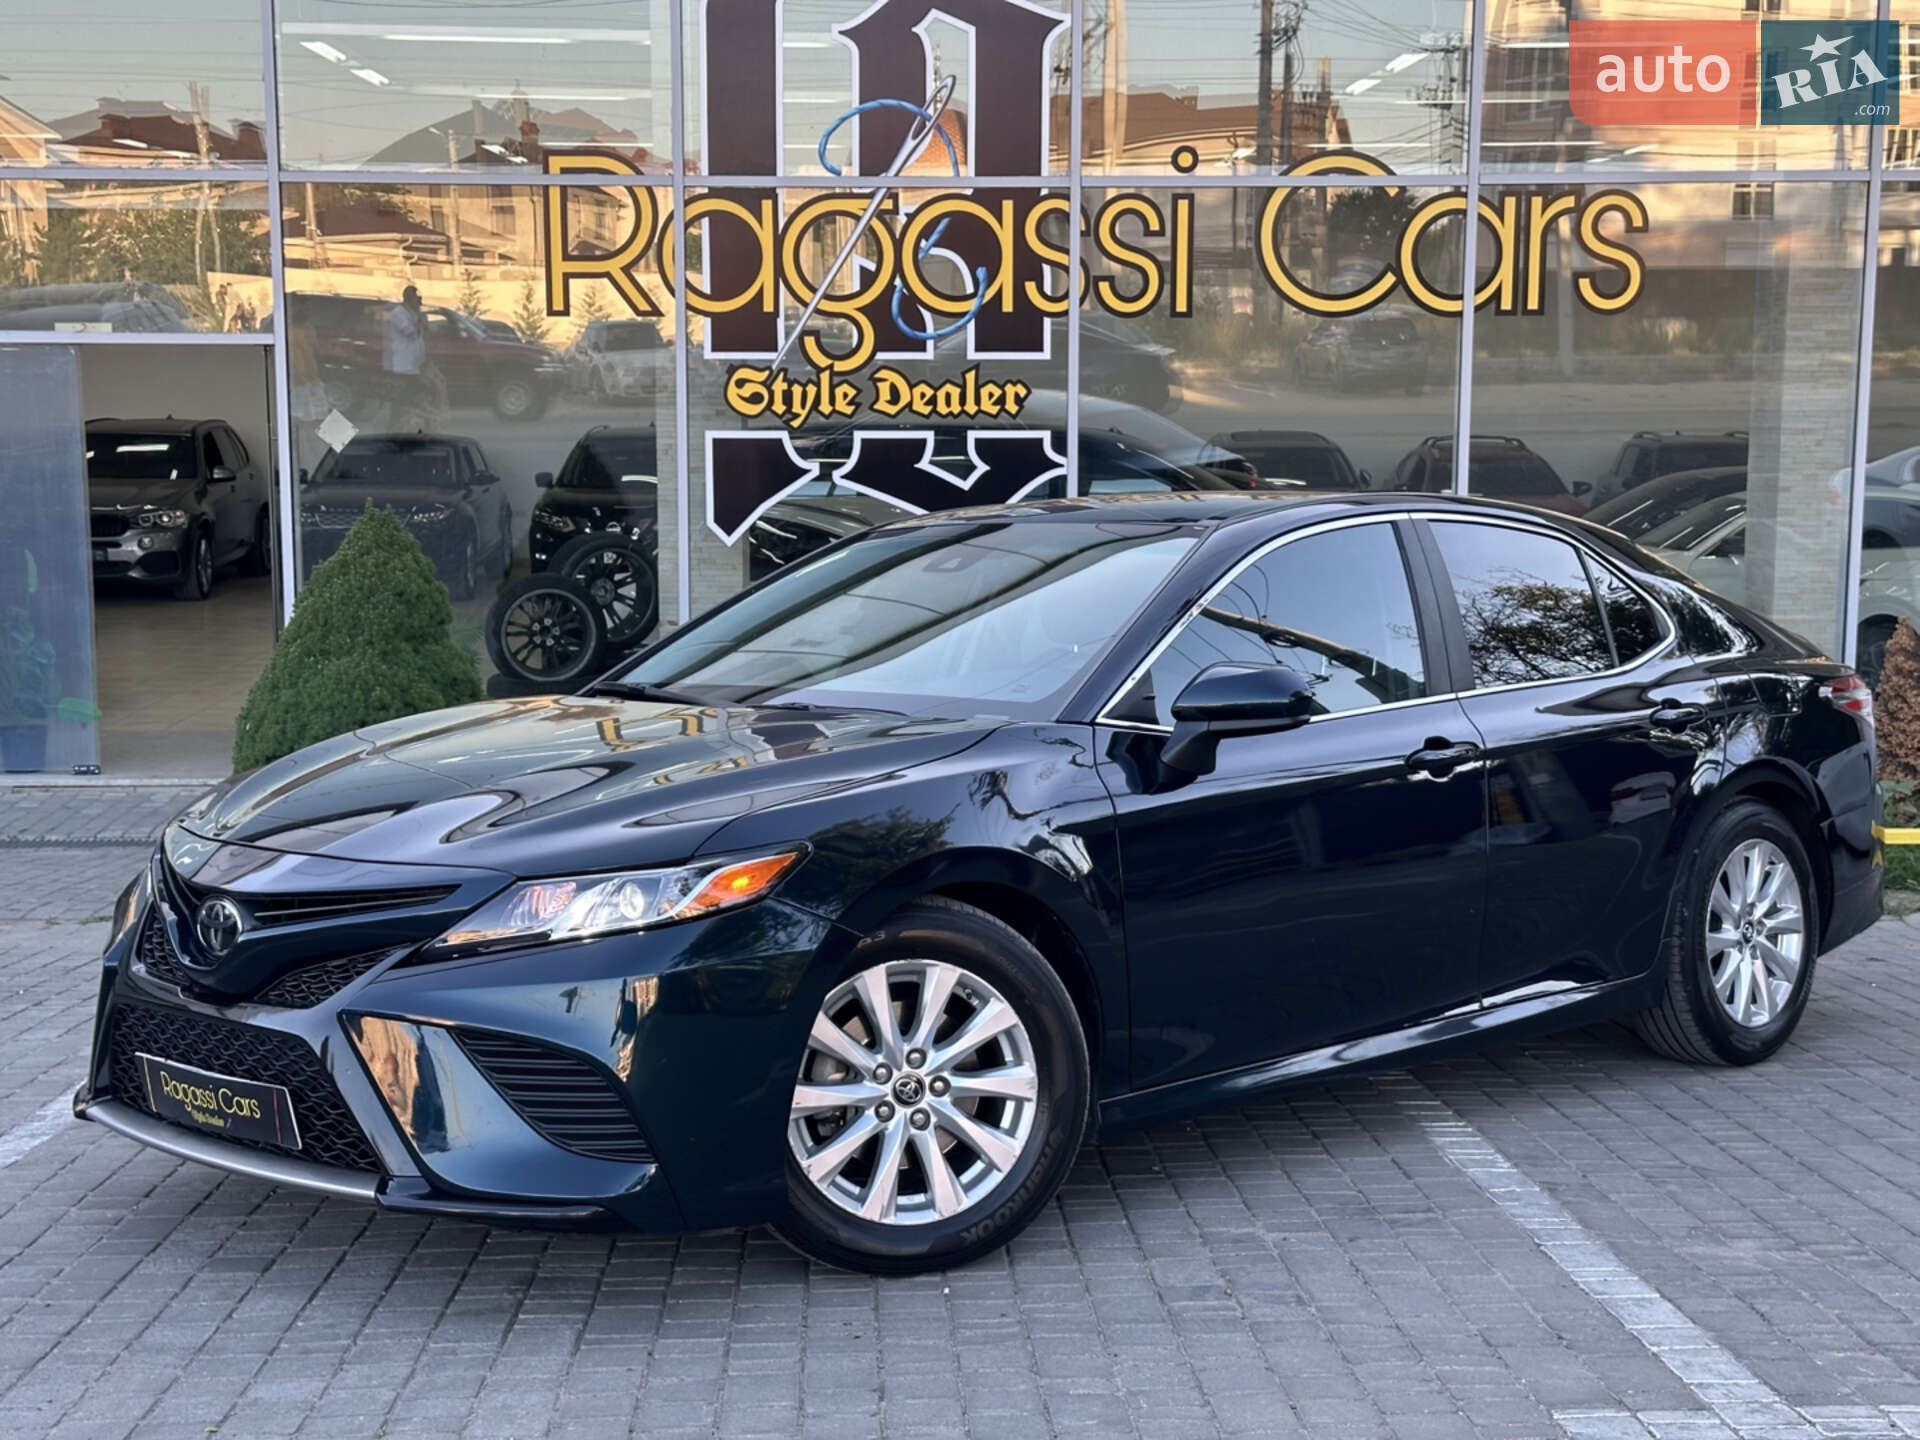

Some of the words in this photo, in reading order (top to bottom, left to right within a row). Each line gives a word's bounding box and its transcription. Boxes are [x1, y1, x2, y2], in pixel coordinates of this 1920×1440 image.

[544, 147, 1195, 374] Ragassi
[1258, 152, 1648, 316] Cars
[726, 366, 856, 427] Style
[874, 366, 1028, 416] Dealer
[160, 1071, 218, 1111] Ragassi
[218, 1088, 261, 1118] Cars
